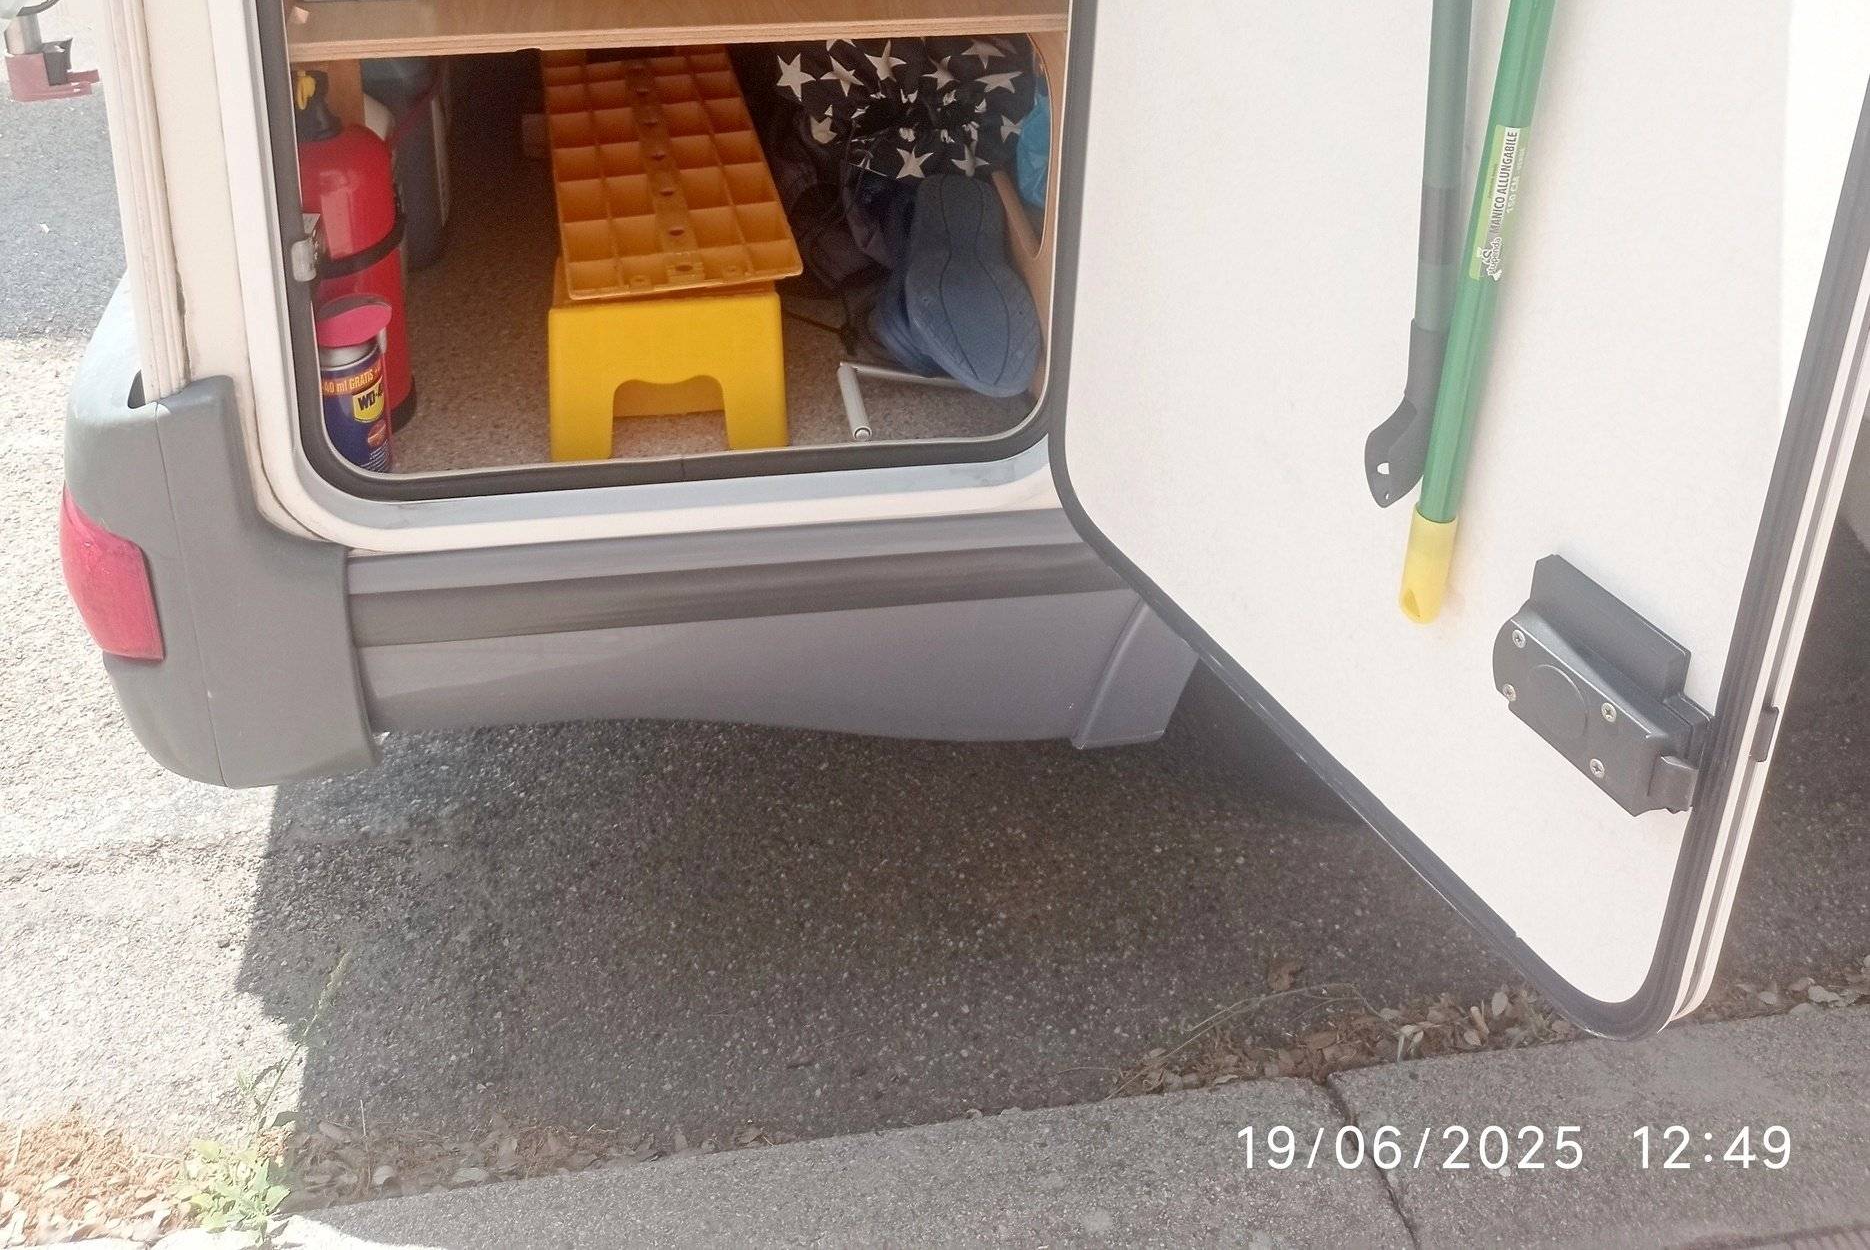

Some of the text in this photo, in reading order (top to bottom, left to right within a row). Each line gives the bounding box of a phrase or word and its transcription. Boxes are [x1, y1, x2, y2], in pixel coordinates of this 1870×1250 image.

[1489, 196, 1505, 234] MANICO
[1497, 132, 1517, 195] ALLUNGABILE
[350, 369, 374, 390] GRATIS
